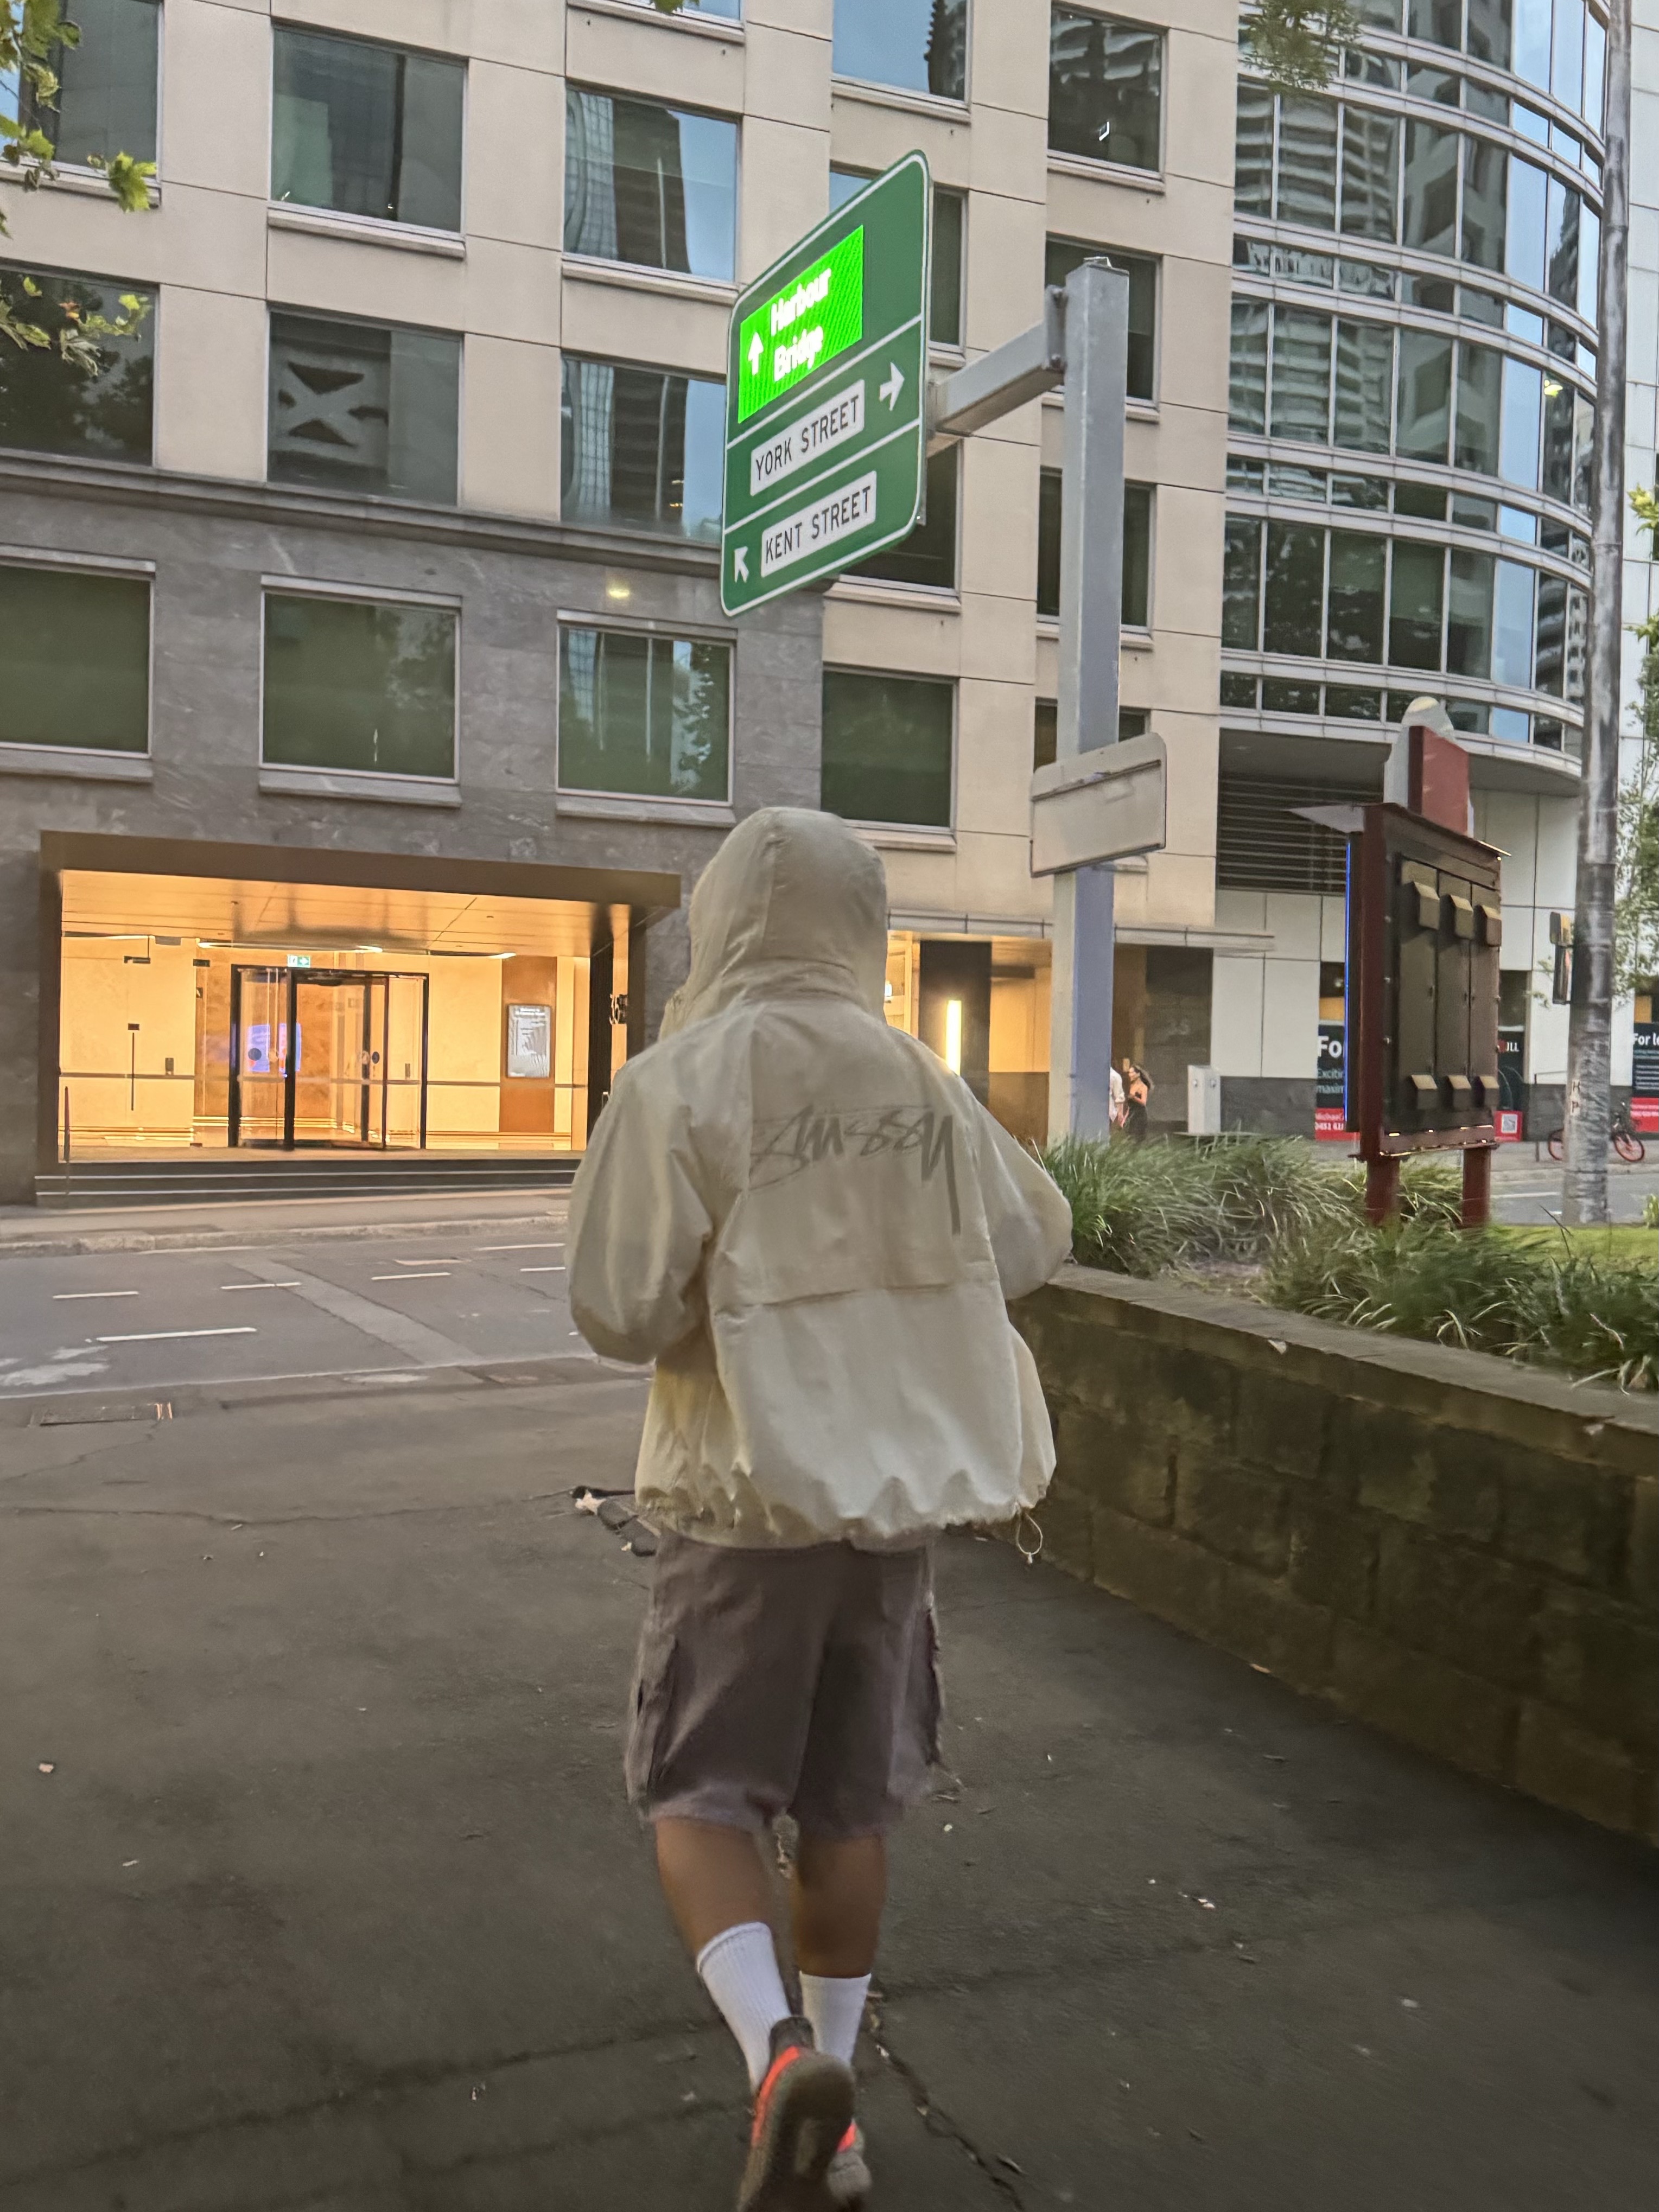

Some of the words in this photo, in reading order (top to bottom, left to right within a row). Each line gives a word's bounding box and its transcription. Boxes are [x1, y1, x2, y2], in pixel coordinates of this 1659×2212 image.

[770, 267, 831, 336] Harbour
[773, 326, 824, 382] Bridge
[755, 437, 792, 481] YORK
[801, 394, 859, 454] STREET
[765, 522, 803, 564] KENT
[811, 486, 871, 540] STREET
[1506, 1041, 1520, 1052] JLL
